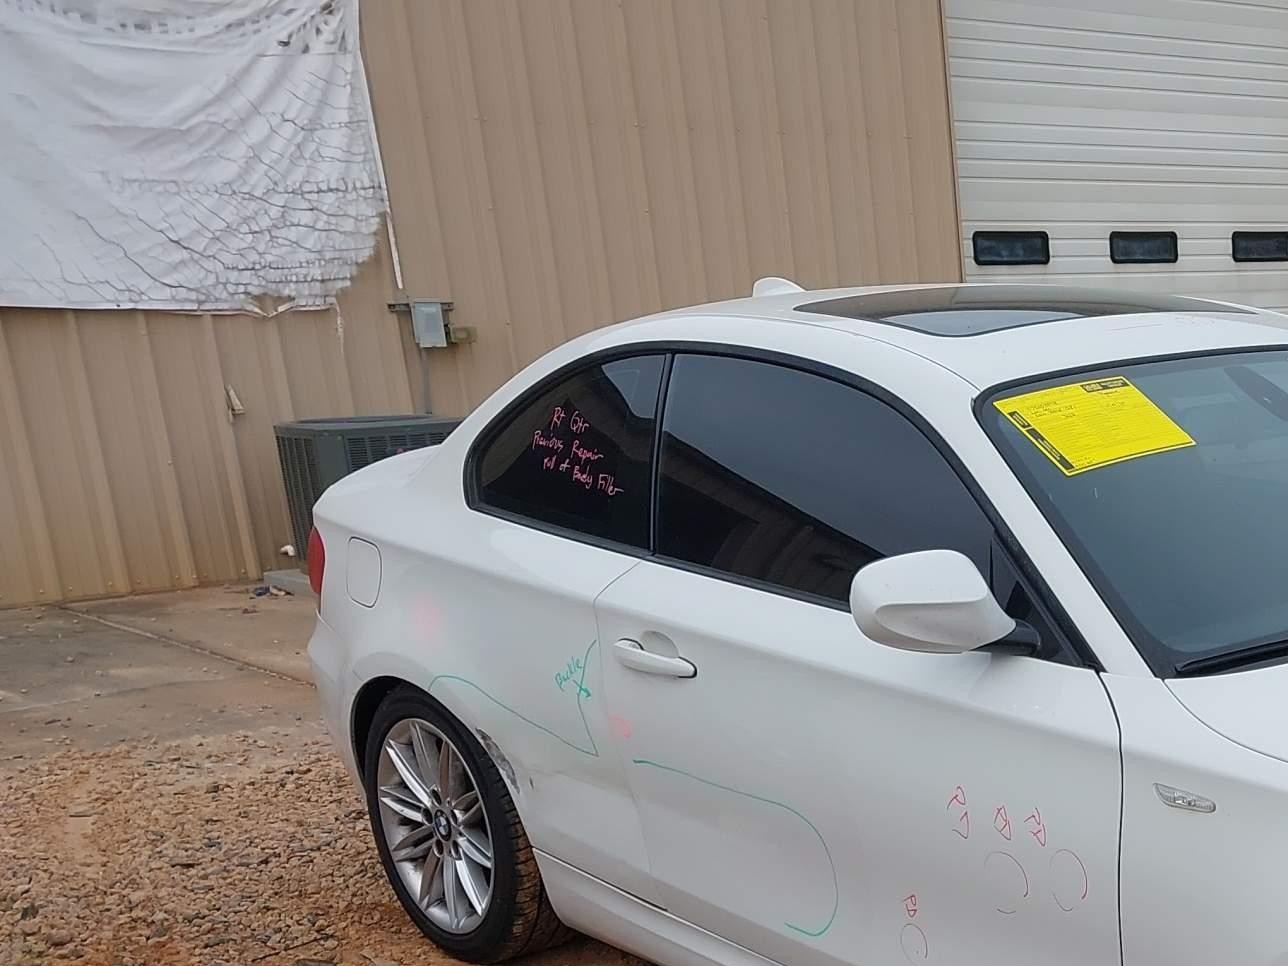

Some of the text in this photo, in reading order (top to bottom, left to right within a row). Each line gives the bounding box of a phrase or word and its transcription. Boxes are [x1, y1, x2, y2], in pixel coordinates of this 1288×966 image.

[571, 439, 604, 465] Repair
[573, 465, 593, 489] Body
[597, 473, 625, 496] Filler
